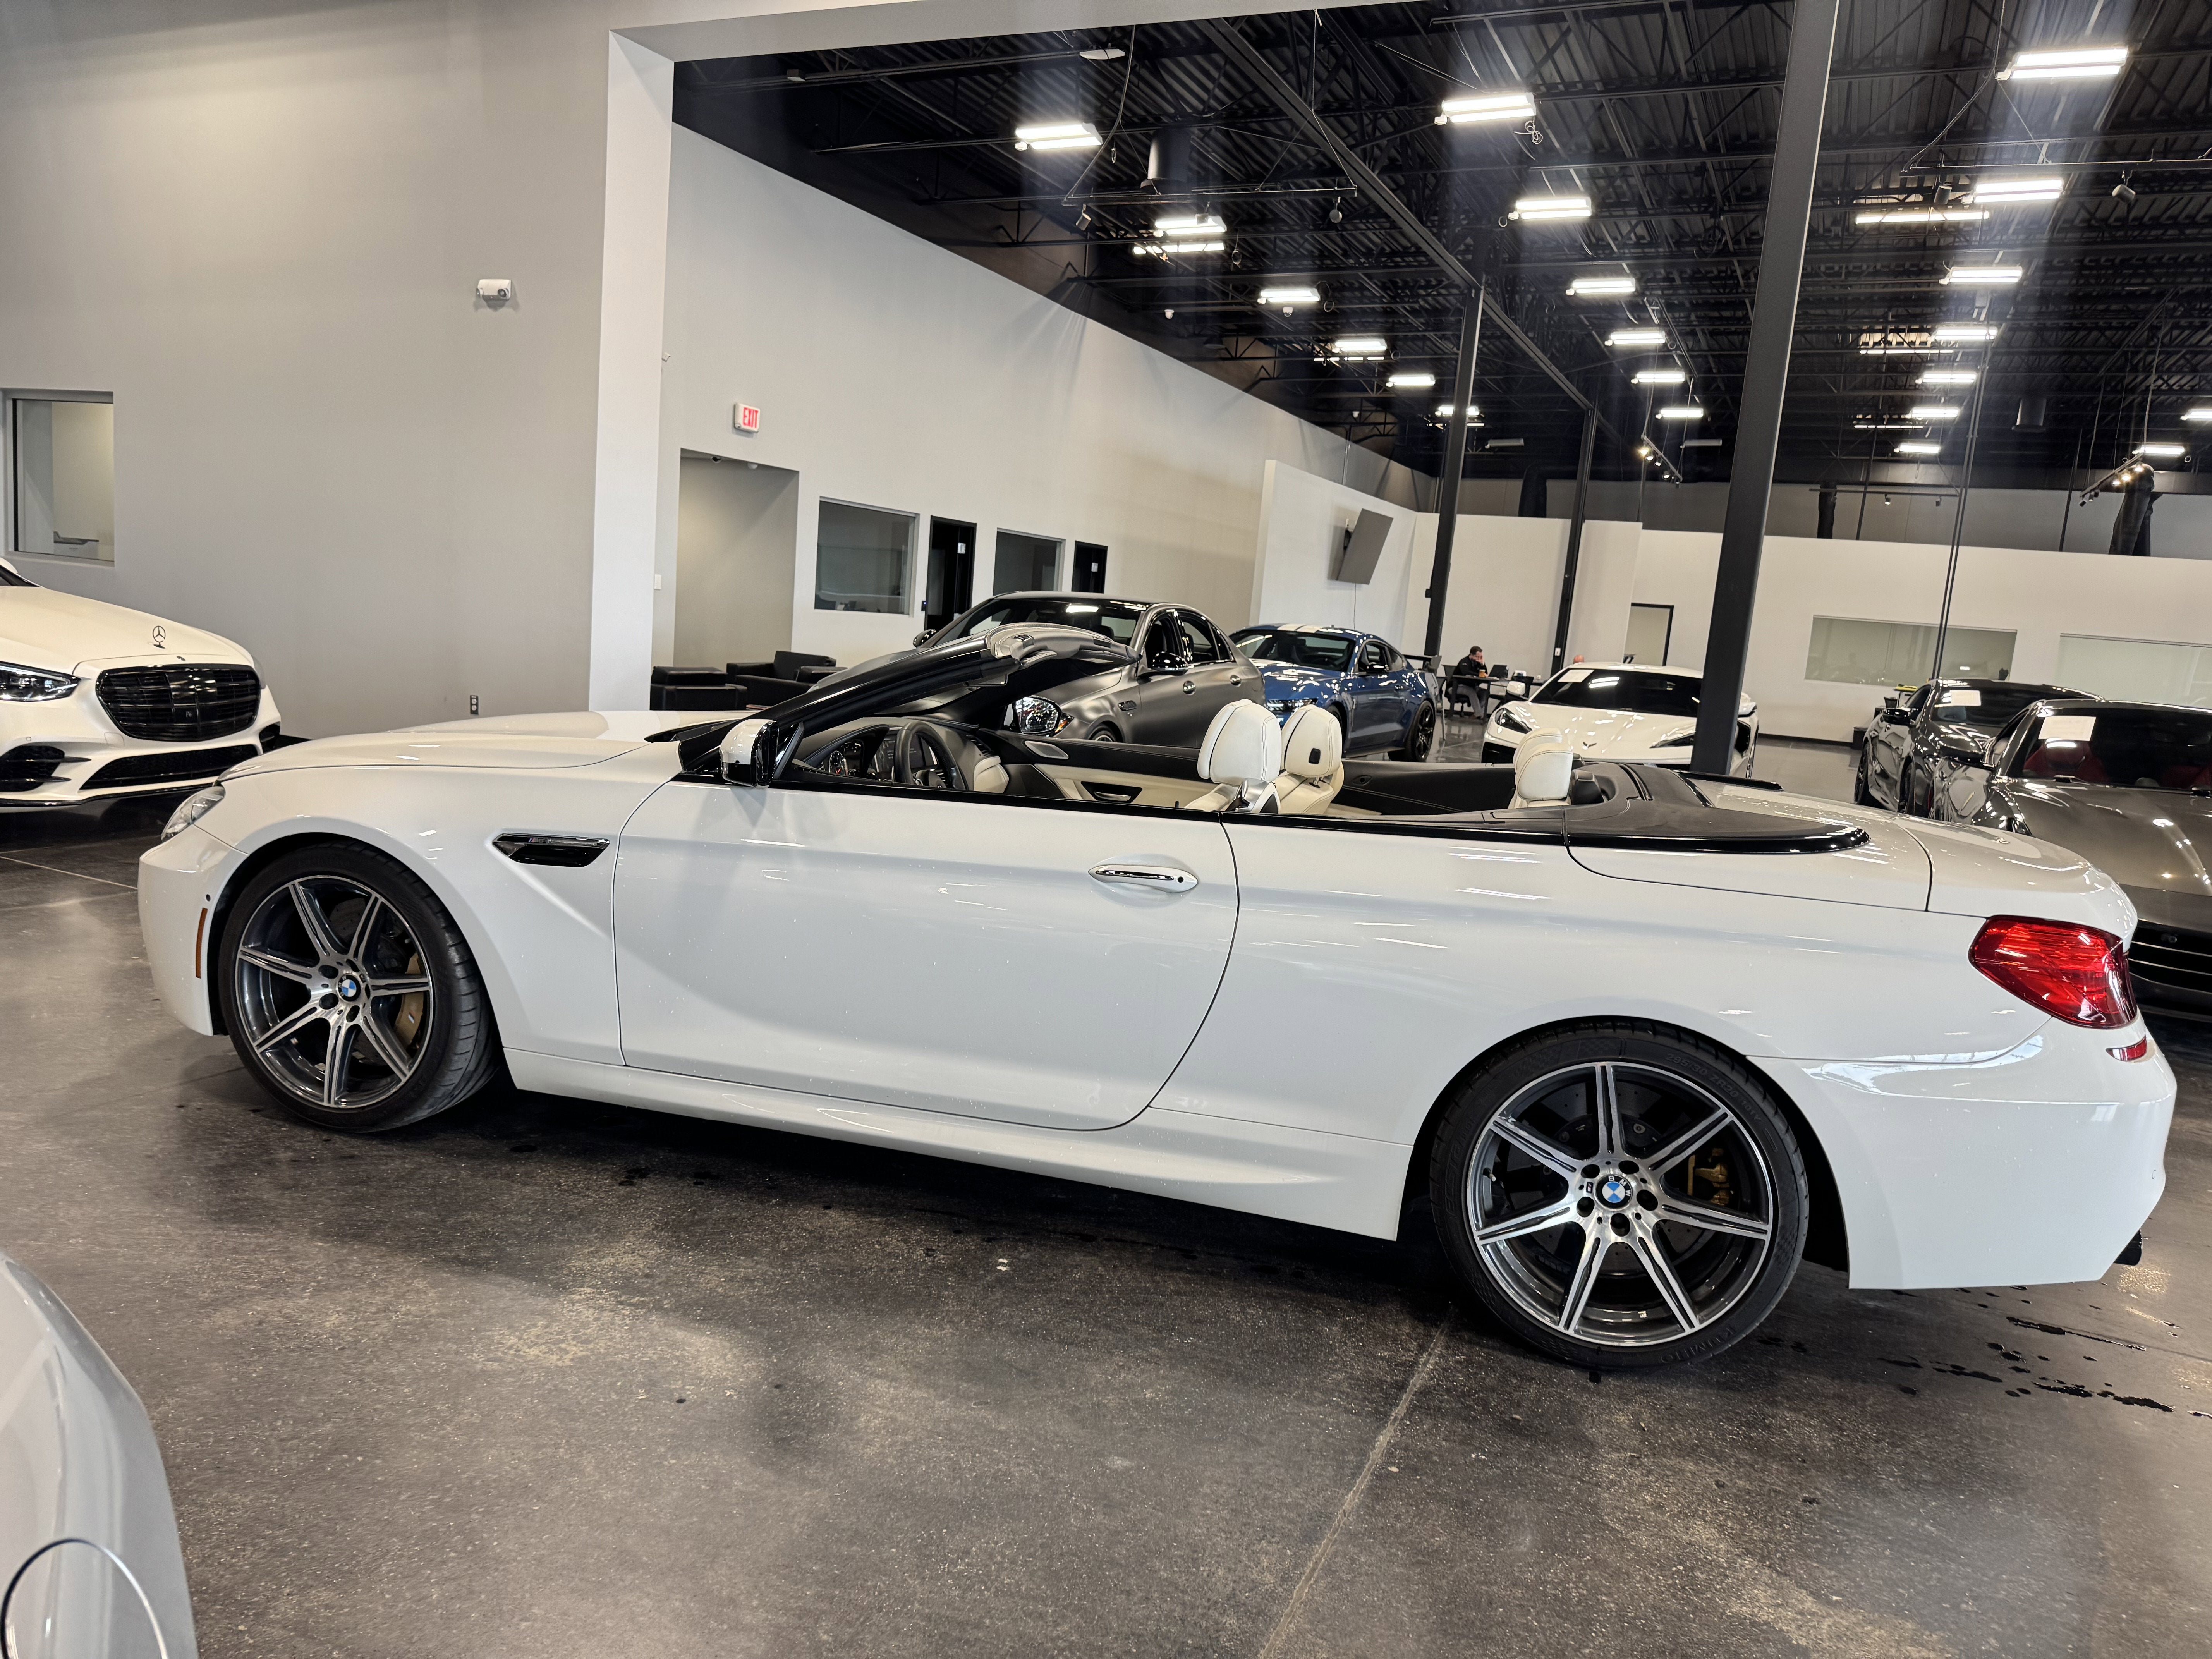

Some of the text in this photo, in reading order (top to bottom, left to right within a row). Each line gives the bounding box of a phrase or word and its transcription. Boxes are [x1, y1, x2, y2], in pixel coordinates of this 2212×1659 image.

[742, 407, 759, 428] EXIT
[1665, 1053, 1708, 1076] 295/30
[1709, 1074, 1739, 1098] ZR20
[1608, 1175, 1631, 1197] BMW
[1660, 1326, 1736, 1363] KUMHO
